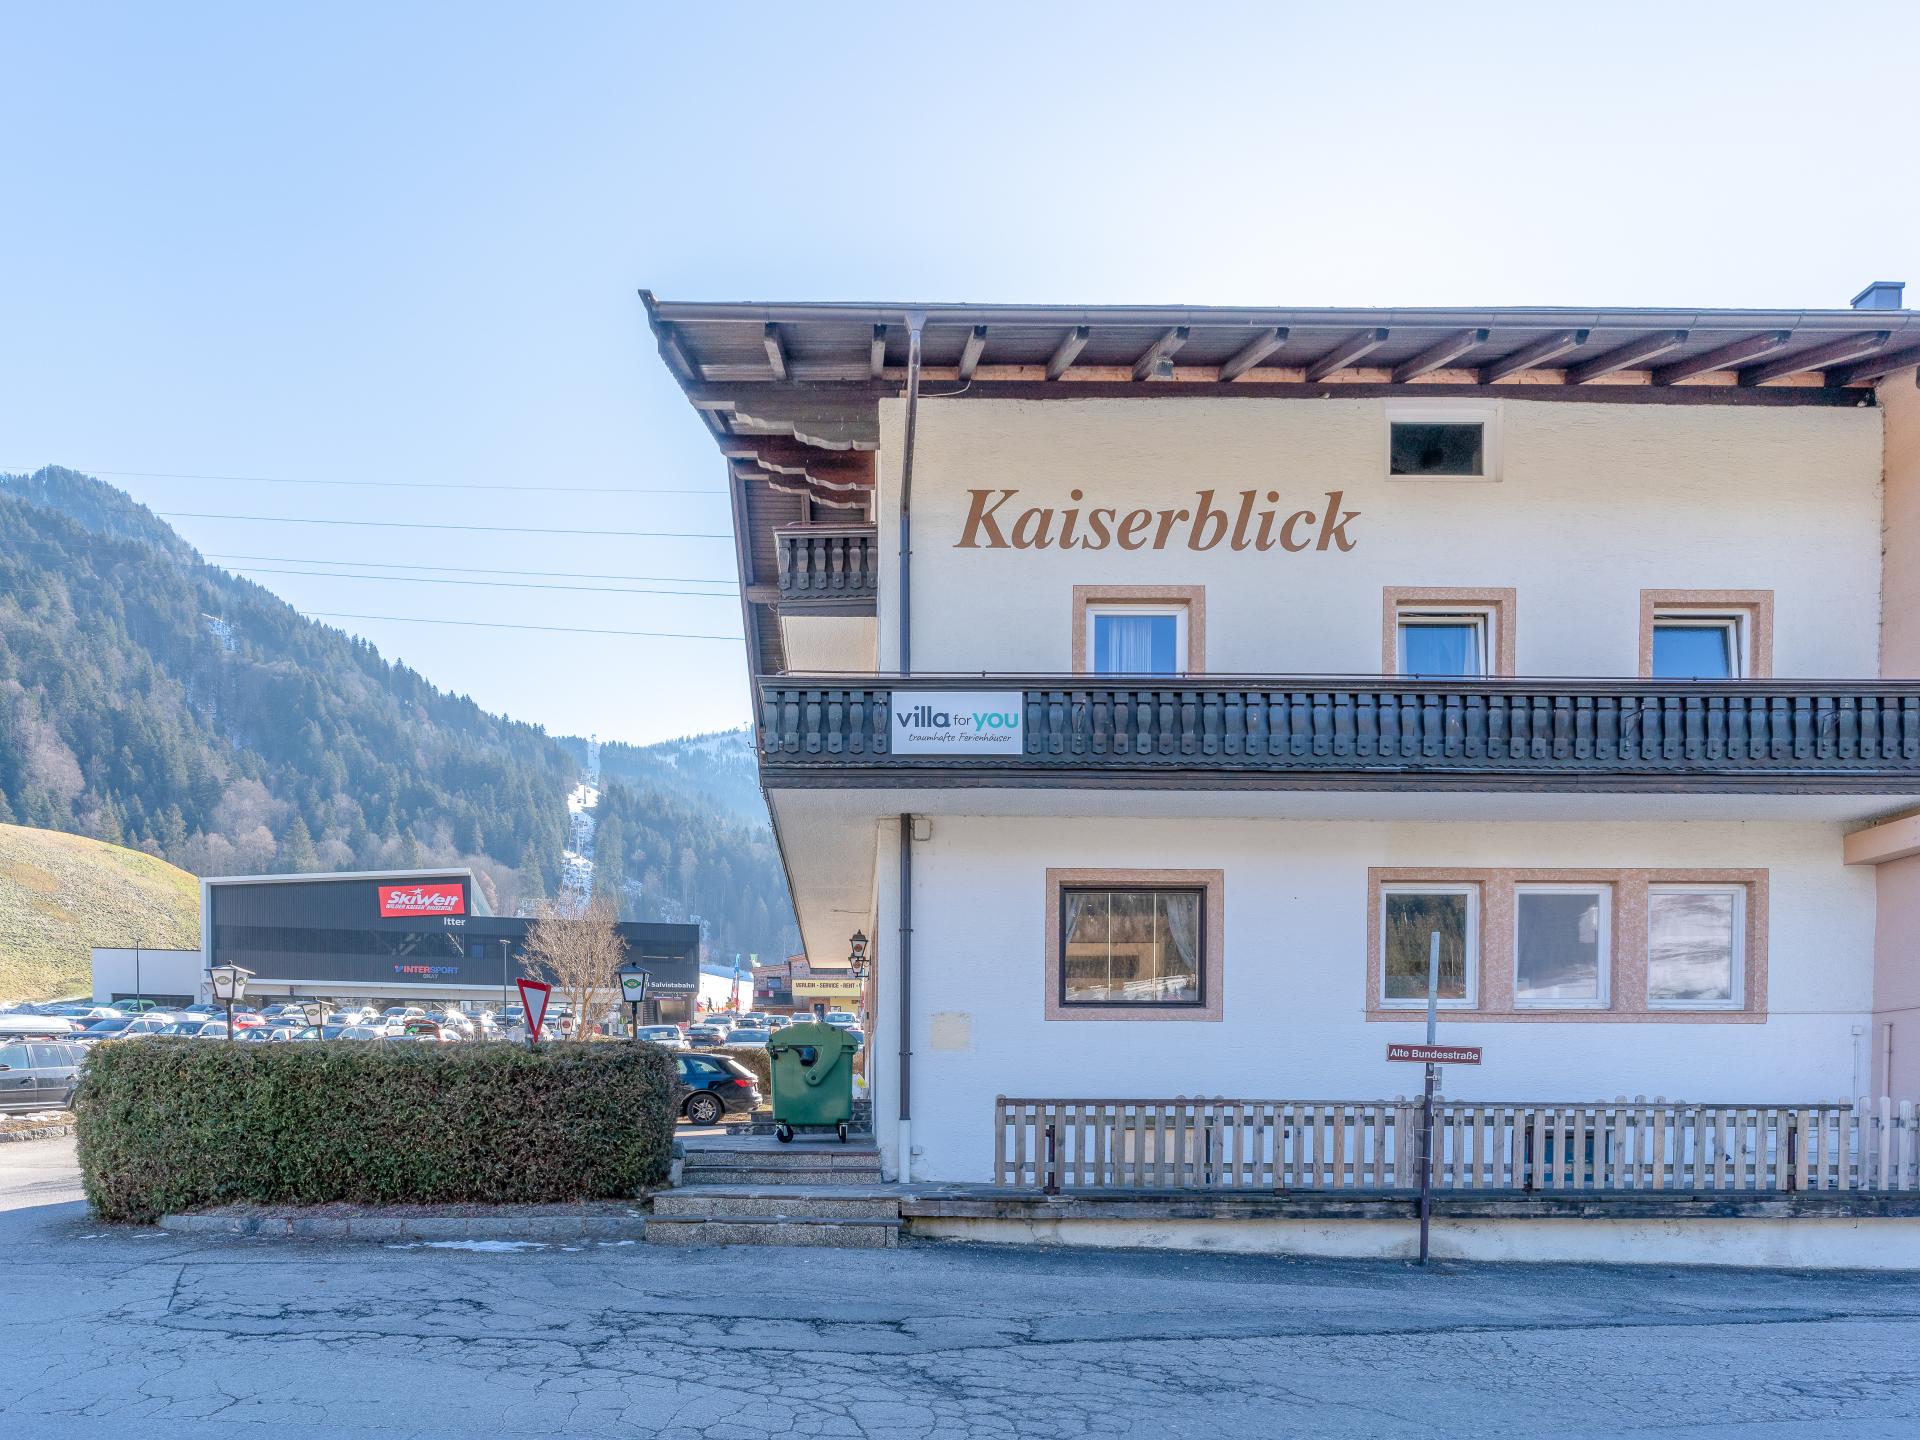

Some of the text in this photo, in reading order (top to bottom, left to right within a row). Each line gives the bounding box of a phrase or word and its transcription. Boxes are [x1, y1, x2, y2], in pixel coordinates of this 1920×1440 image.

[952, 489, 1362, 552] Kaiserblick
[896, 705, 1019, 731] villa for you
[908, 731, 1012, 743] traumhafte Ferienhäuser
[387, 890, 459, 906] SkiWelt
[443, 916, 466, 926] Itter
[403, 965, 459, 974] INTERSPORT
[651, 981, 695, 989] Salvistabahn
[1390, 1048, 1479, 1060] Alte Bundesstraße
